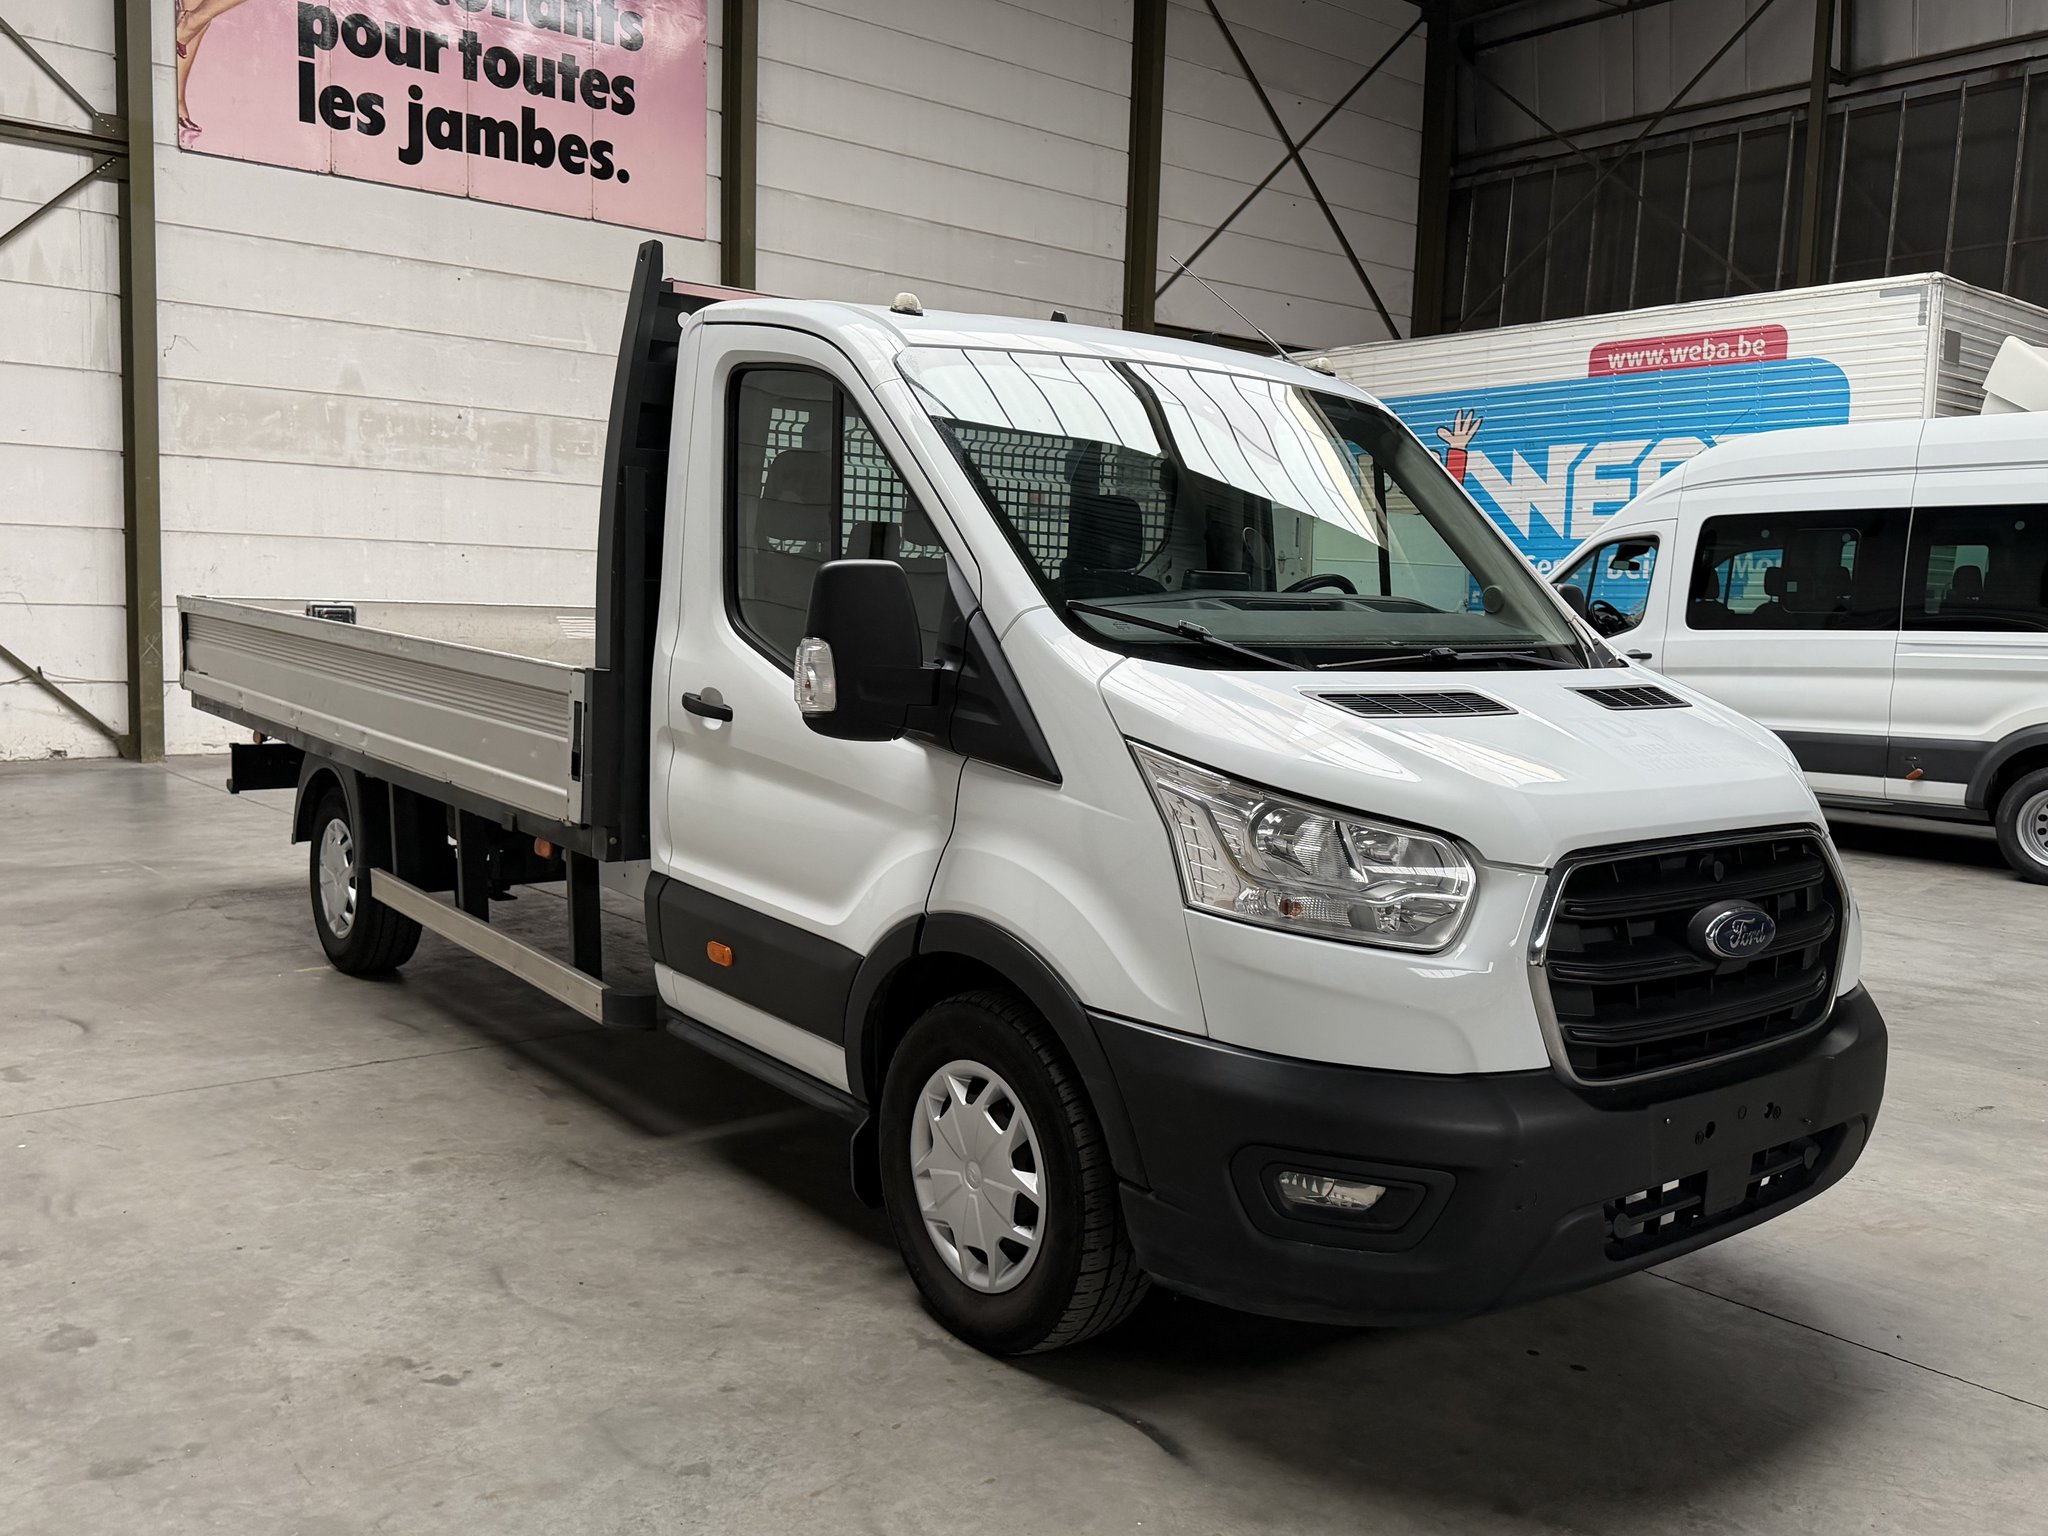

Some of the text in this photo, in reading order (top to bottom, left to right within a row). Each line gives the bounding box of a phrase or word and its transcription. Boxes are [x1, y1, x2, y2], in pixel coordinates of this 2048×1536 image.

[298, 3, 636, 116] pour toutes
[298, 58, 631, 184] les jambes.
[1607, 334, 1767, 369] www.weba.be
[1730, 918, 1766, 949] Ford
